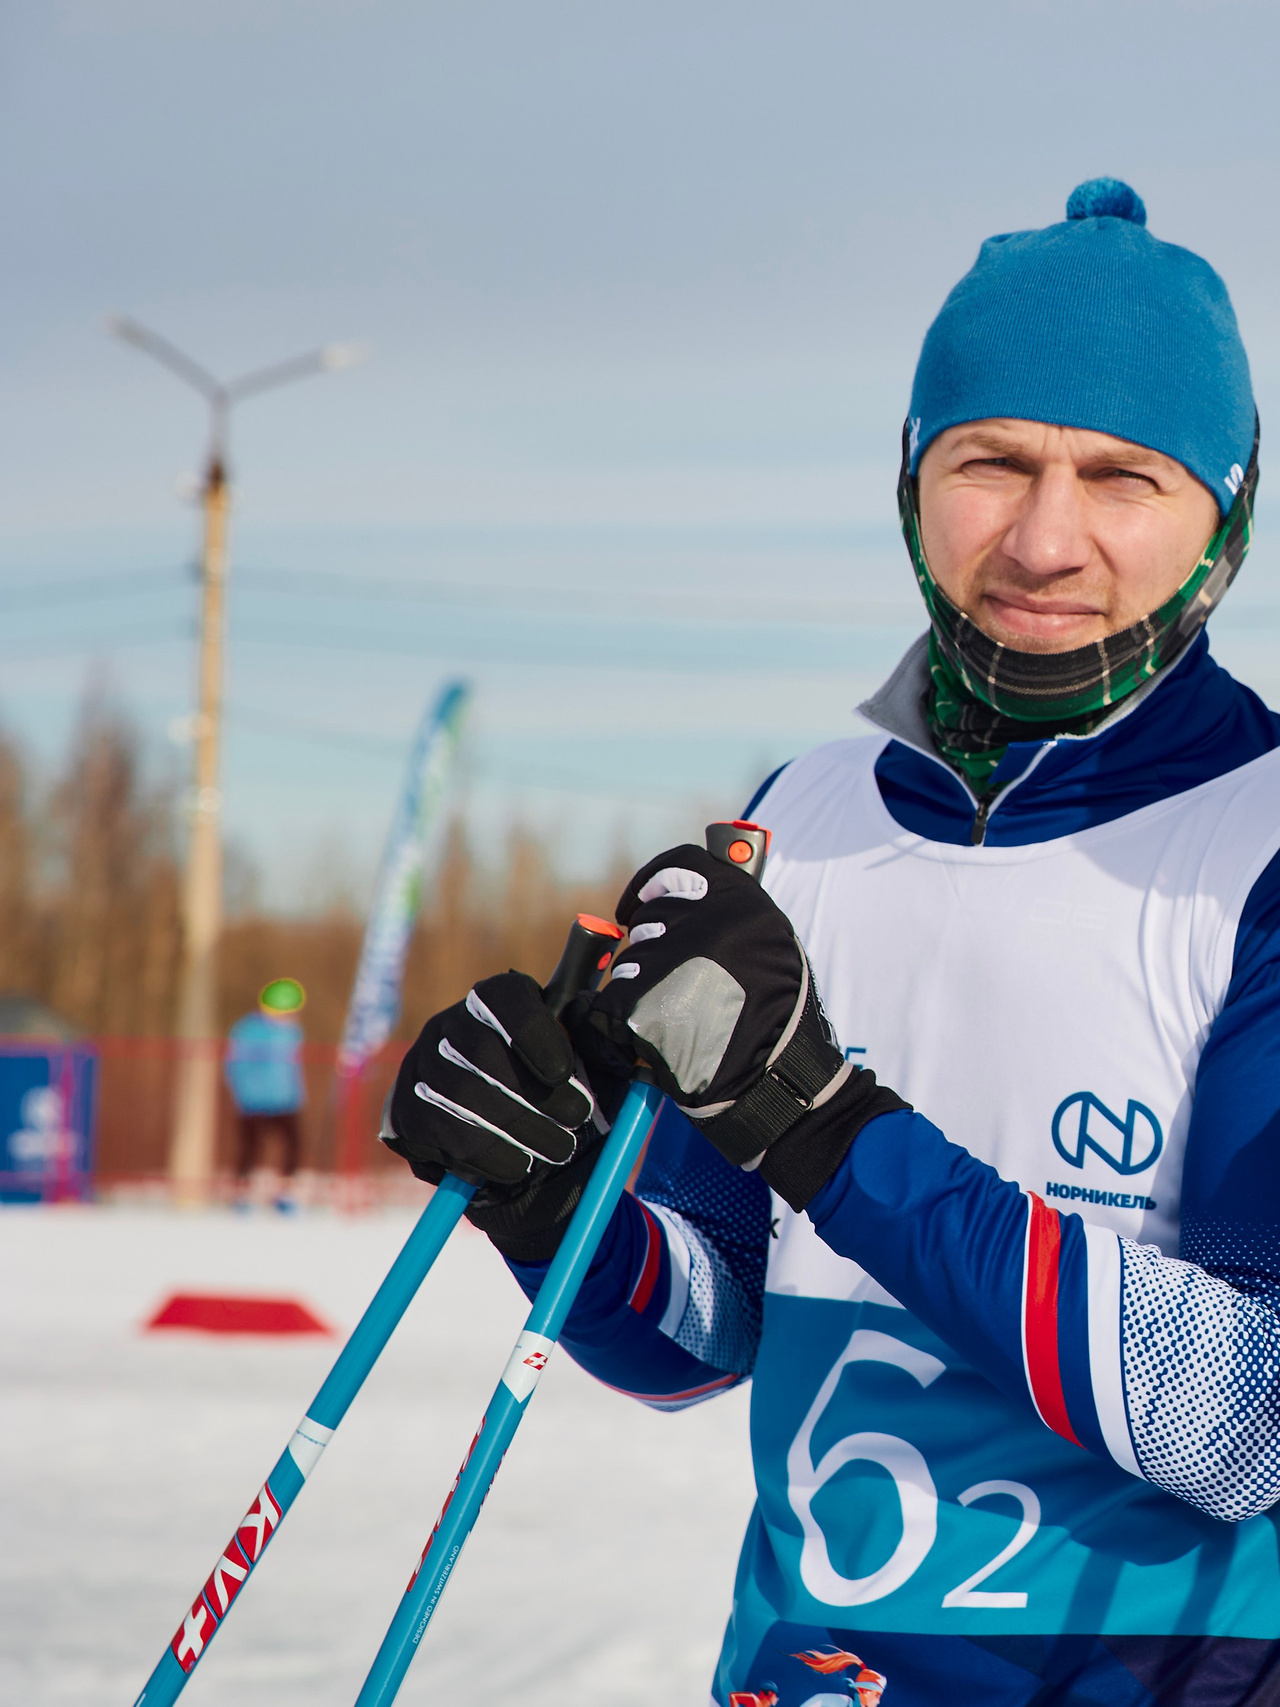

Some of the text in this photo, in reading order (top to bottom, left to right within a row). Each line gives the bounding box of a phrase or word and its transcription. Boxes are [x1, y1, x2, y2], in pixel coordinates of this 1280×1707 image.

[1046, 1181, 1157, 1211] НОРНИКЕЛЬ
[412, 1545, 460, 1644] DESIGNED IN SWITZERLAND
